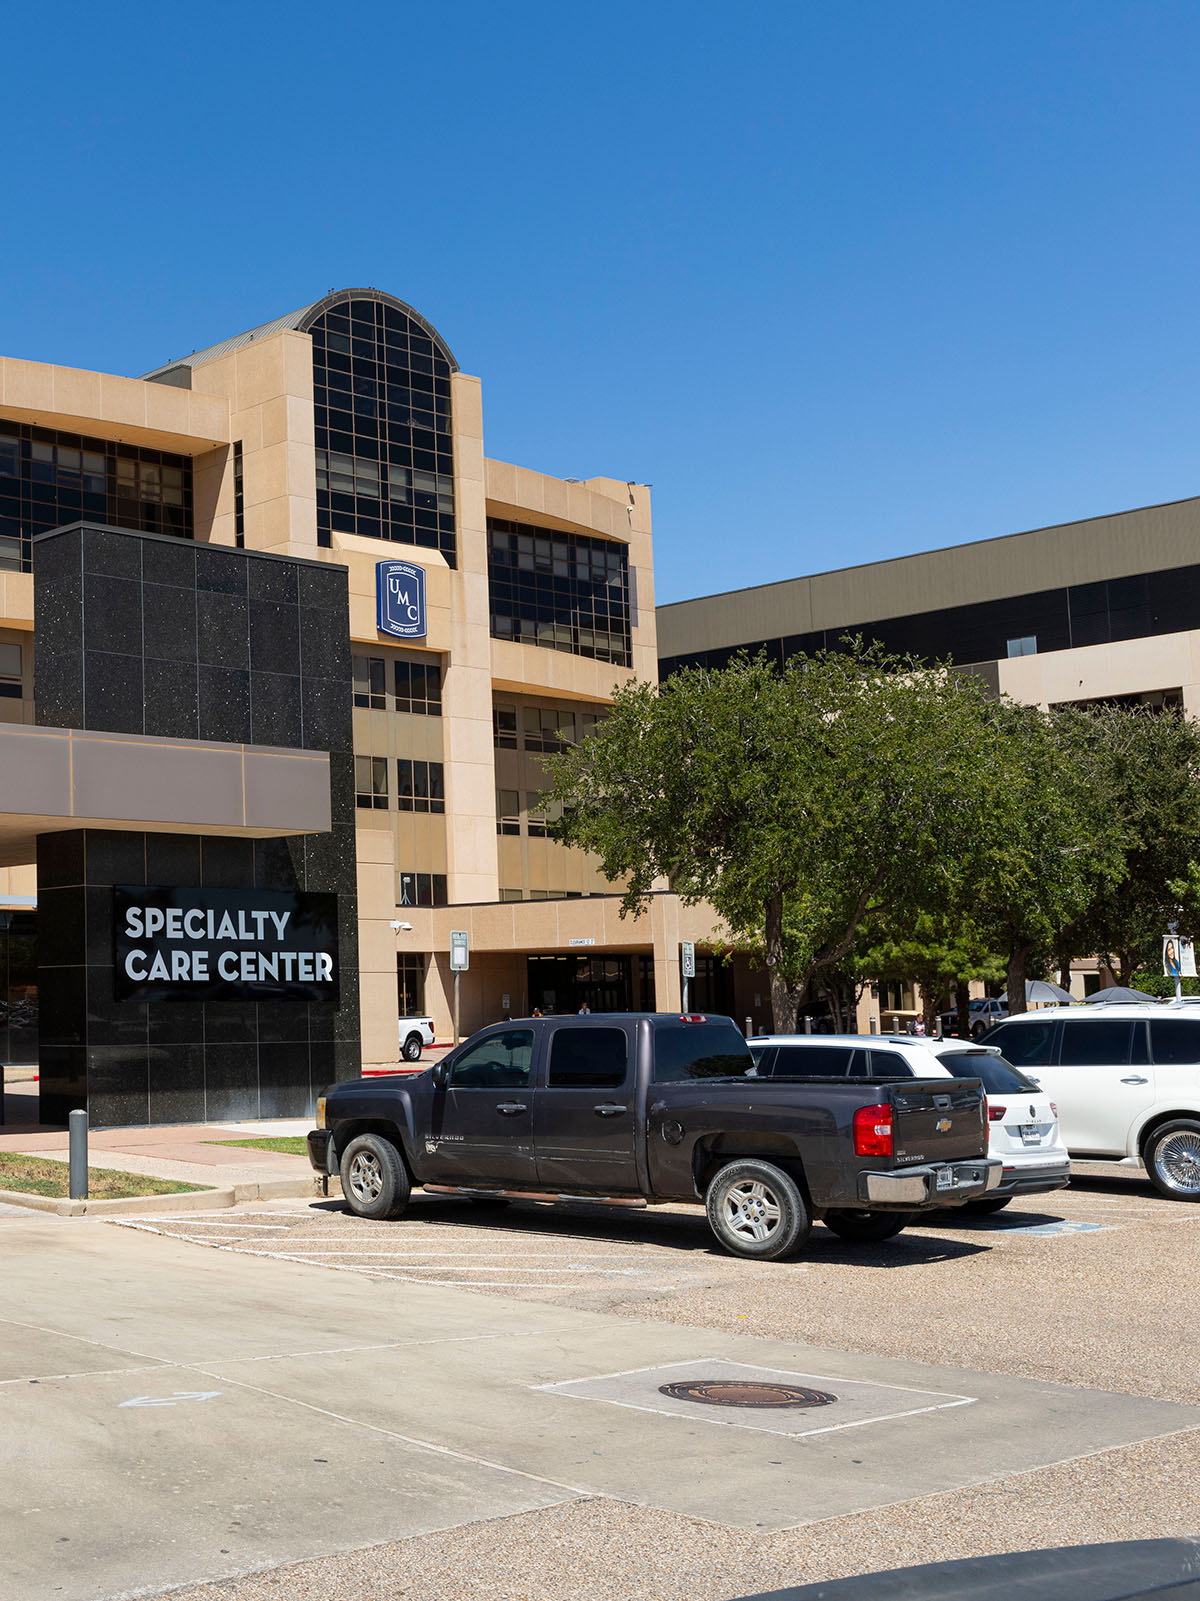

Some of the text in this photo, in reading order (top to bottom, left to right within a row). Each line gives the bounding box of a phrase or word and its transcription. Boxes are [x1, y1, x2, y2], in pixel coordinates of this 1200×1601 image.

[389, 578, 418, 621] UMC
[124, 906, 291, 941] SPECIALTY
[124, 949, 334, 982] CARE CENTER
[424, 1133, 465, 1141] SILVERADO
